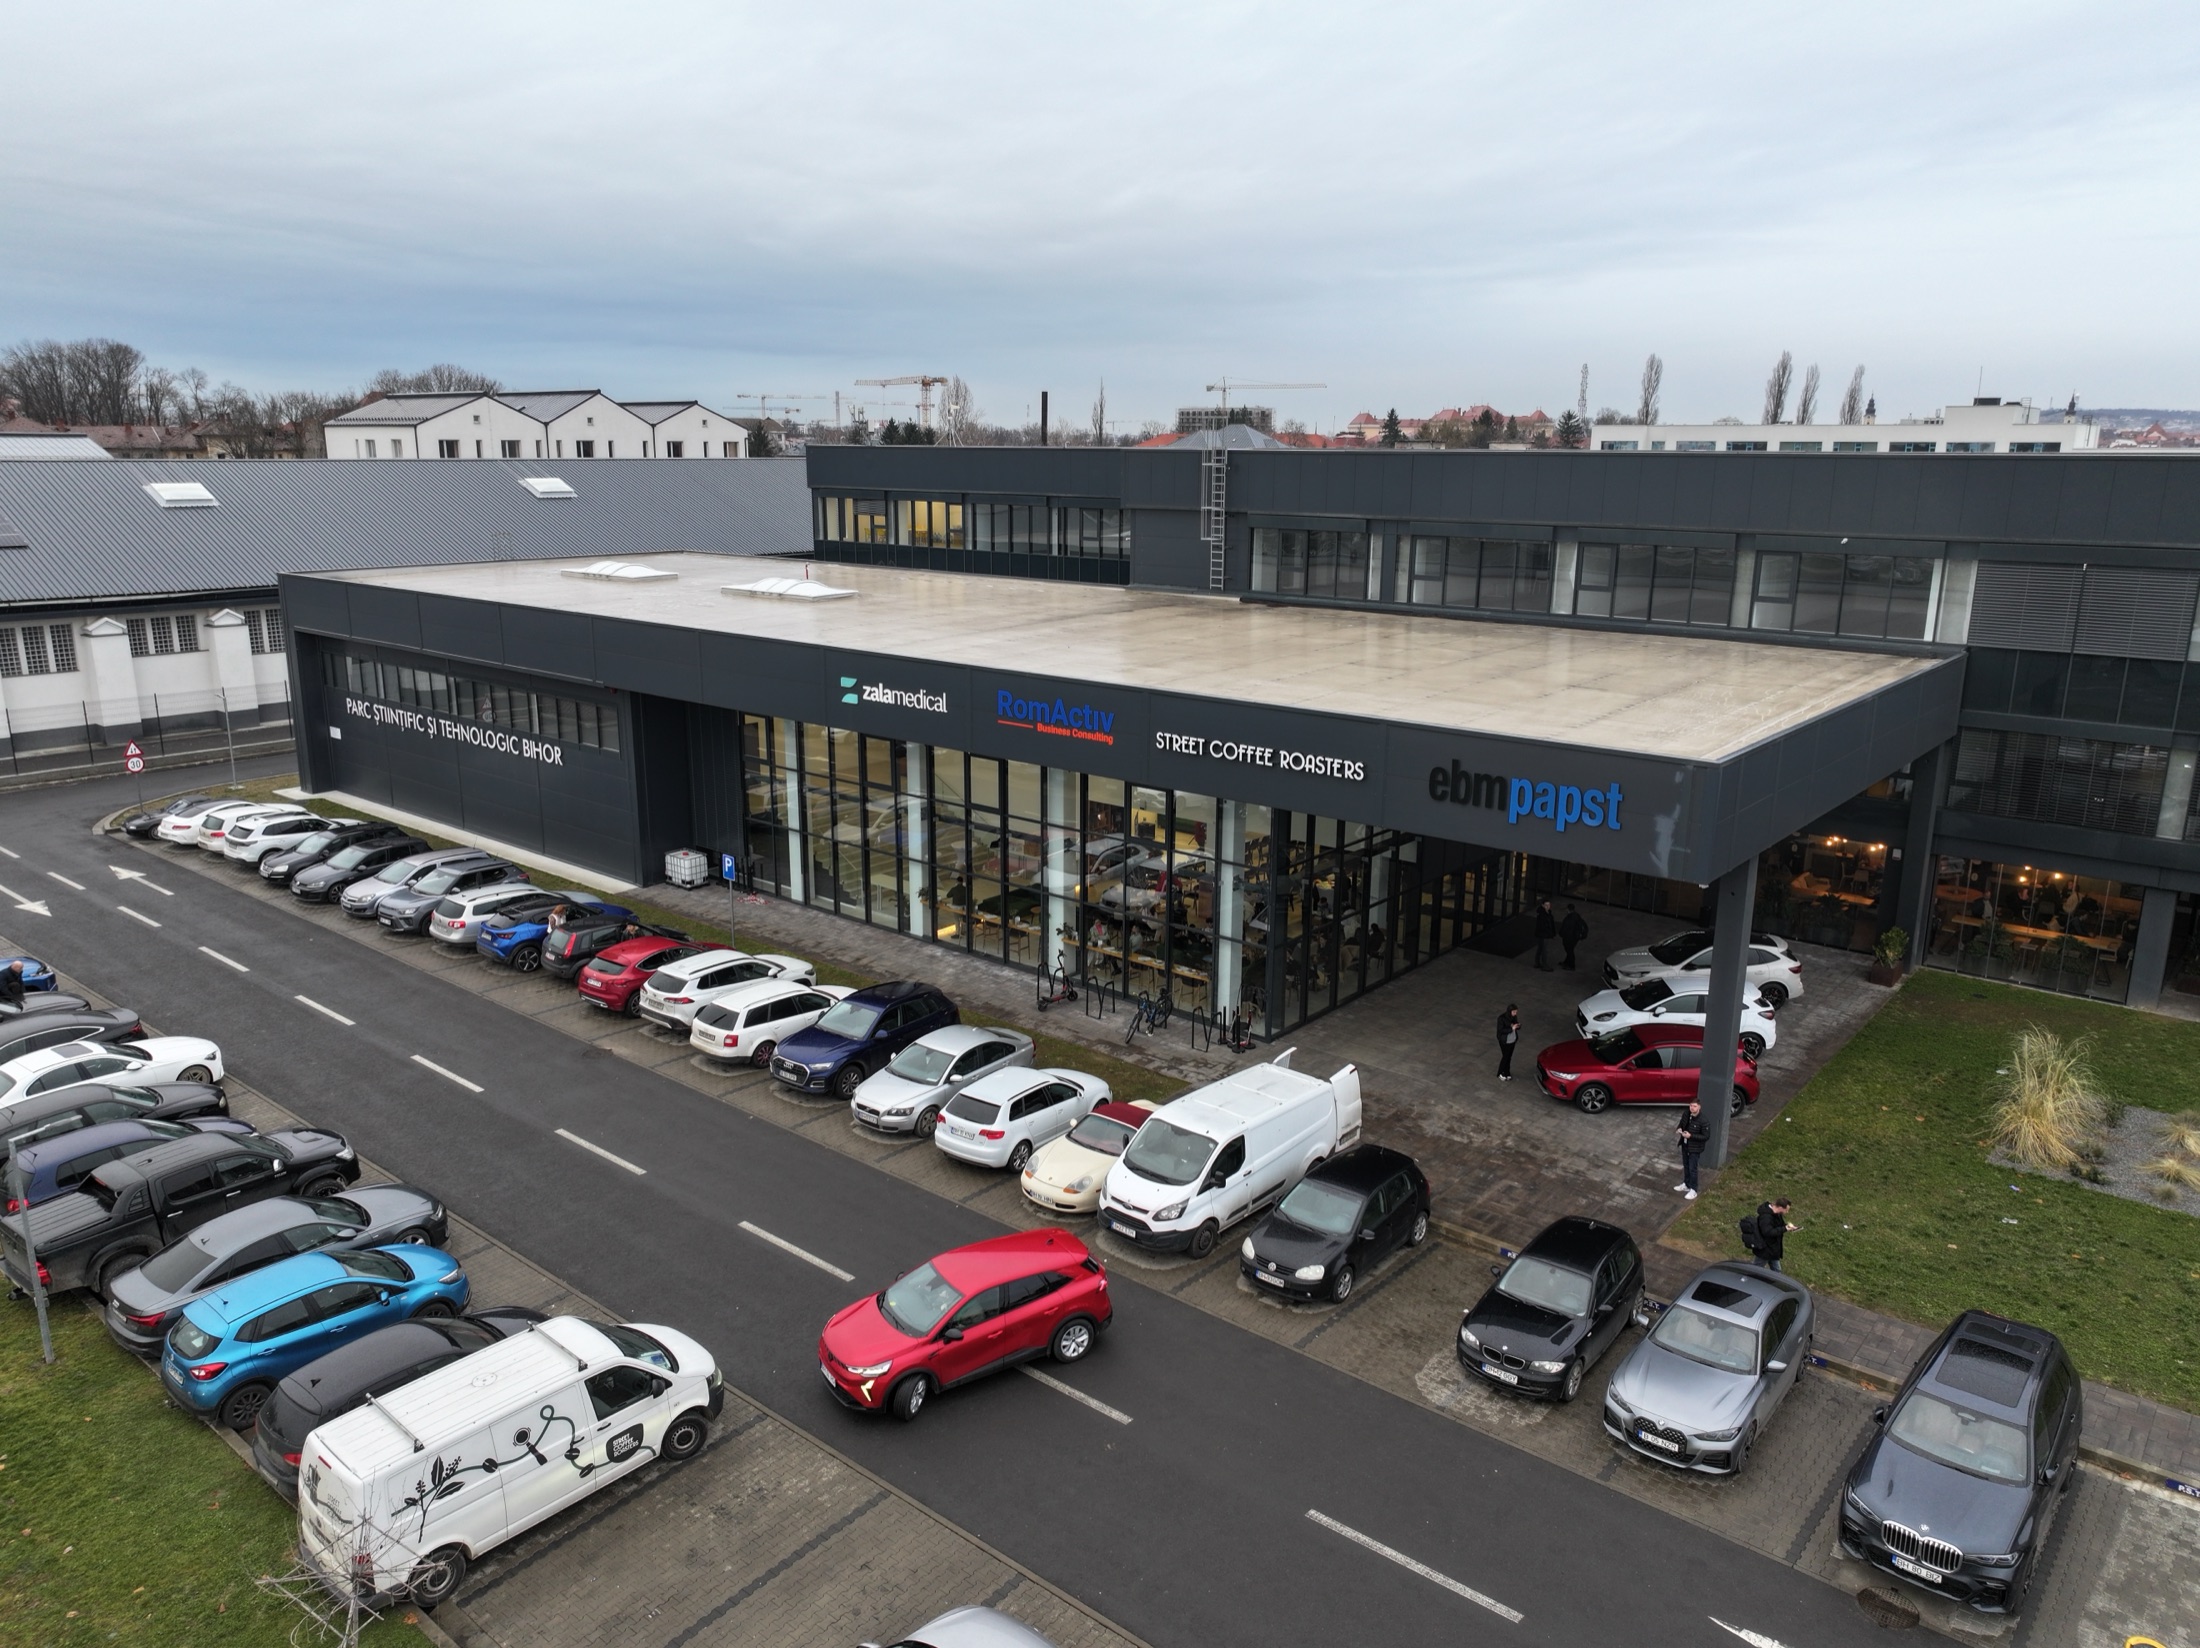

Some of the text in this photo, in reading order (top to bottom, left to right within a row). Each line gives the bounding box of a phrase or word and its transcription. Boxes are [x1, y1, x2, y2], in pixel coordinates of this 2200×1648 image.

[862, 682, 948, 713] zalamedical
[997, 689, 1115, 733] RomActiv
[345, 697, 563, 766] PARC ȘTIINȚIFIC ȘI TEHNOLOGIC BIHOR
[1036, 721, 1114, 746] Business Consulting
[130, 760, 141, 769] 30
[1155, 731, 1365, 781] STREET COFFEE ROASTERS
[1428, 759, 1624, 832] ebmpapst
[725, 857, 732, 872] P
